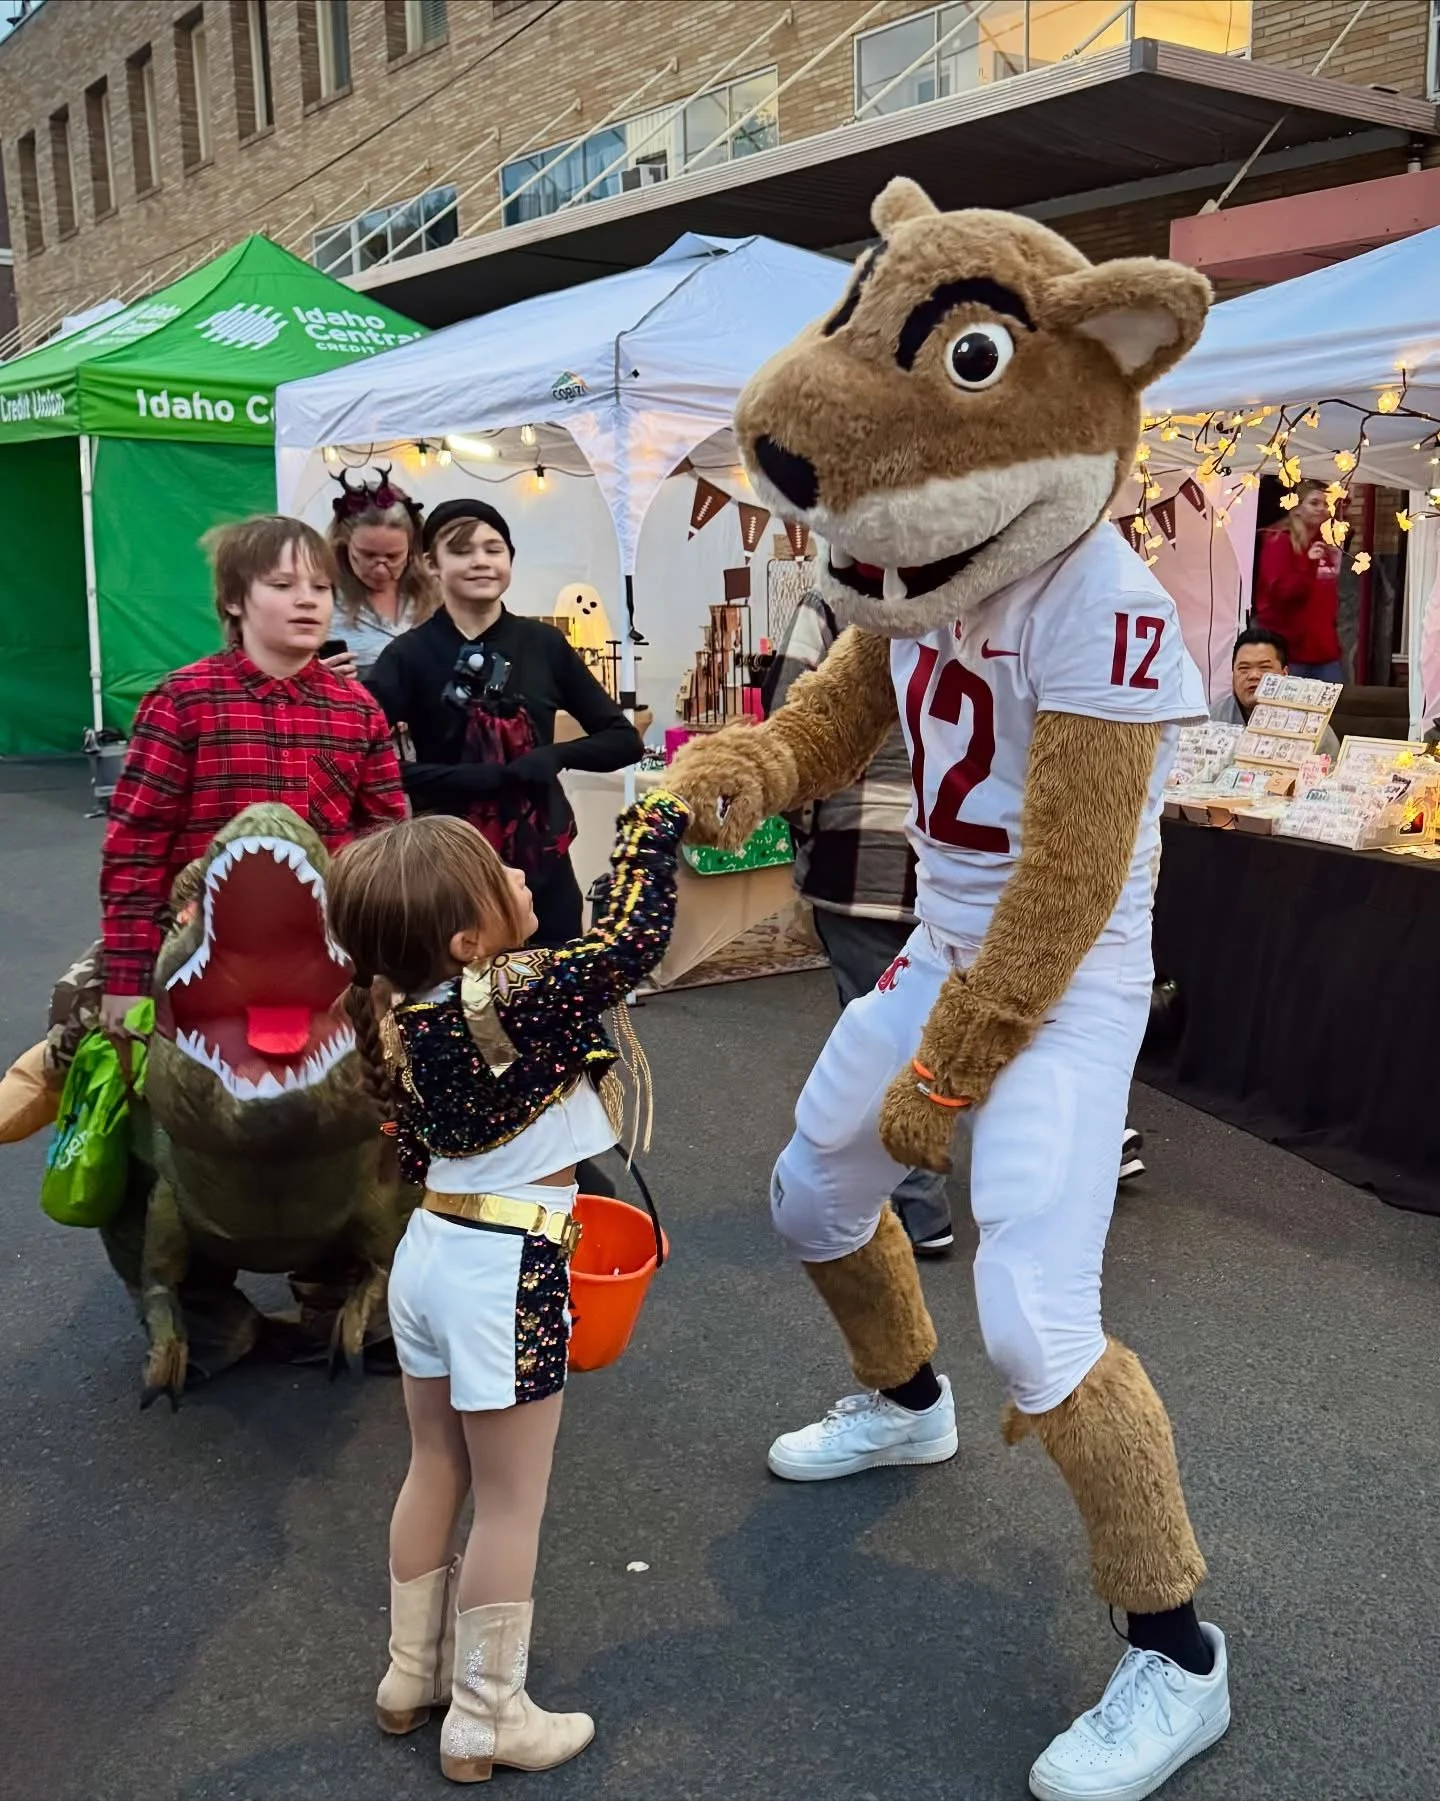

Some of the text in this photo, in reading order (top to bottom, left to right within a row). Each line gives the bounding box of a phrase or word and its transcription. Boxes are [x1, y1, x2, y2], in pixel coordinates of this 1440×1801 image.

[292, 306, 386, 329] Idaho
[315, 342, 376, 354] CREDIT
[0, 387, 65, 422] Credit Union
[136, 388, 235, 422] Idaho
[1110, 612, 1166, 690] 12
[906, 642, 1010, 854] 12
